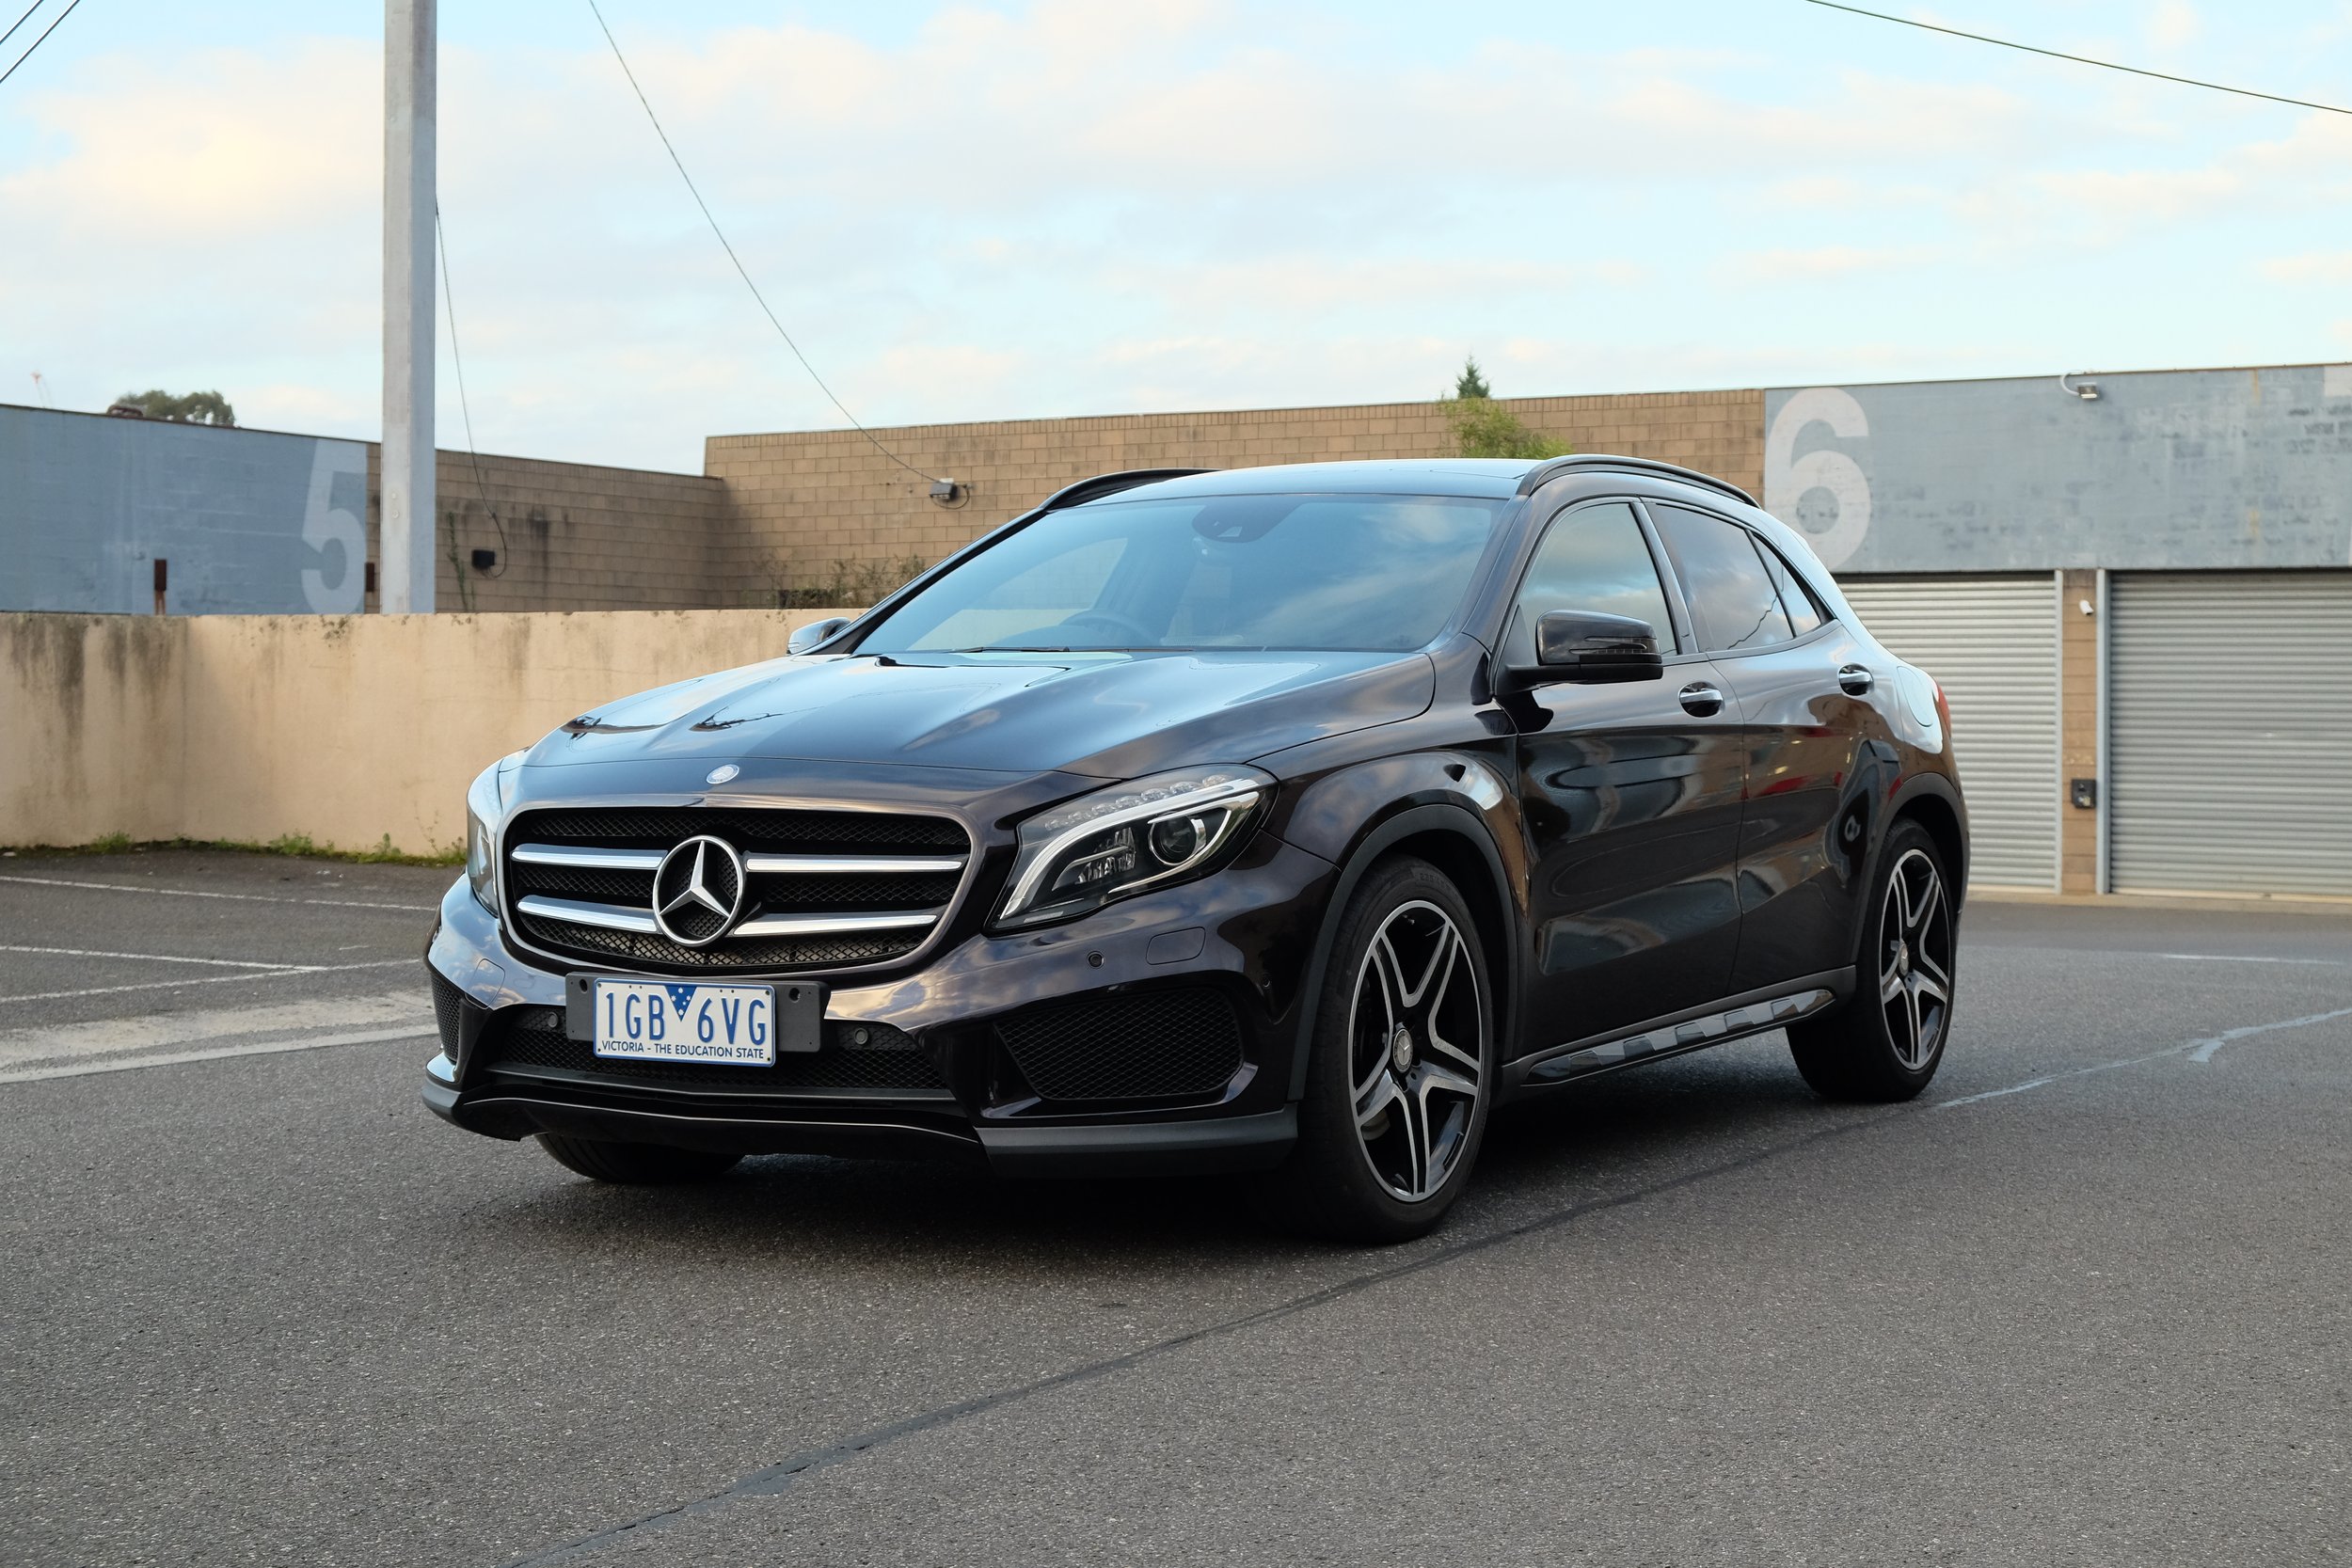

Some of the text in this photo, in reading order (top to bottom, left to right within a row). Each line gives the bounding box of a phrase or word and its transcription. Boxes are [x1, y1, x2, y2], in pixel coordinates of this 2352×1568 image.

[300, 437, 367, 614] 5
[1764, 387, 1871, 570] 6
[602, 1039, 644, 1053] VICTORIA
[654, 1042, 672, 1054] THE
[675, 1044, 733, 1058] EDUCATION
[736, 1047, 764, 1059] STATE
[606, 992, 766, 1046] 1GB 6VG
